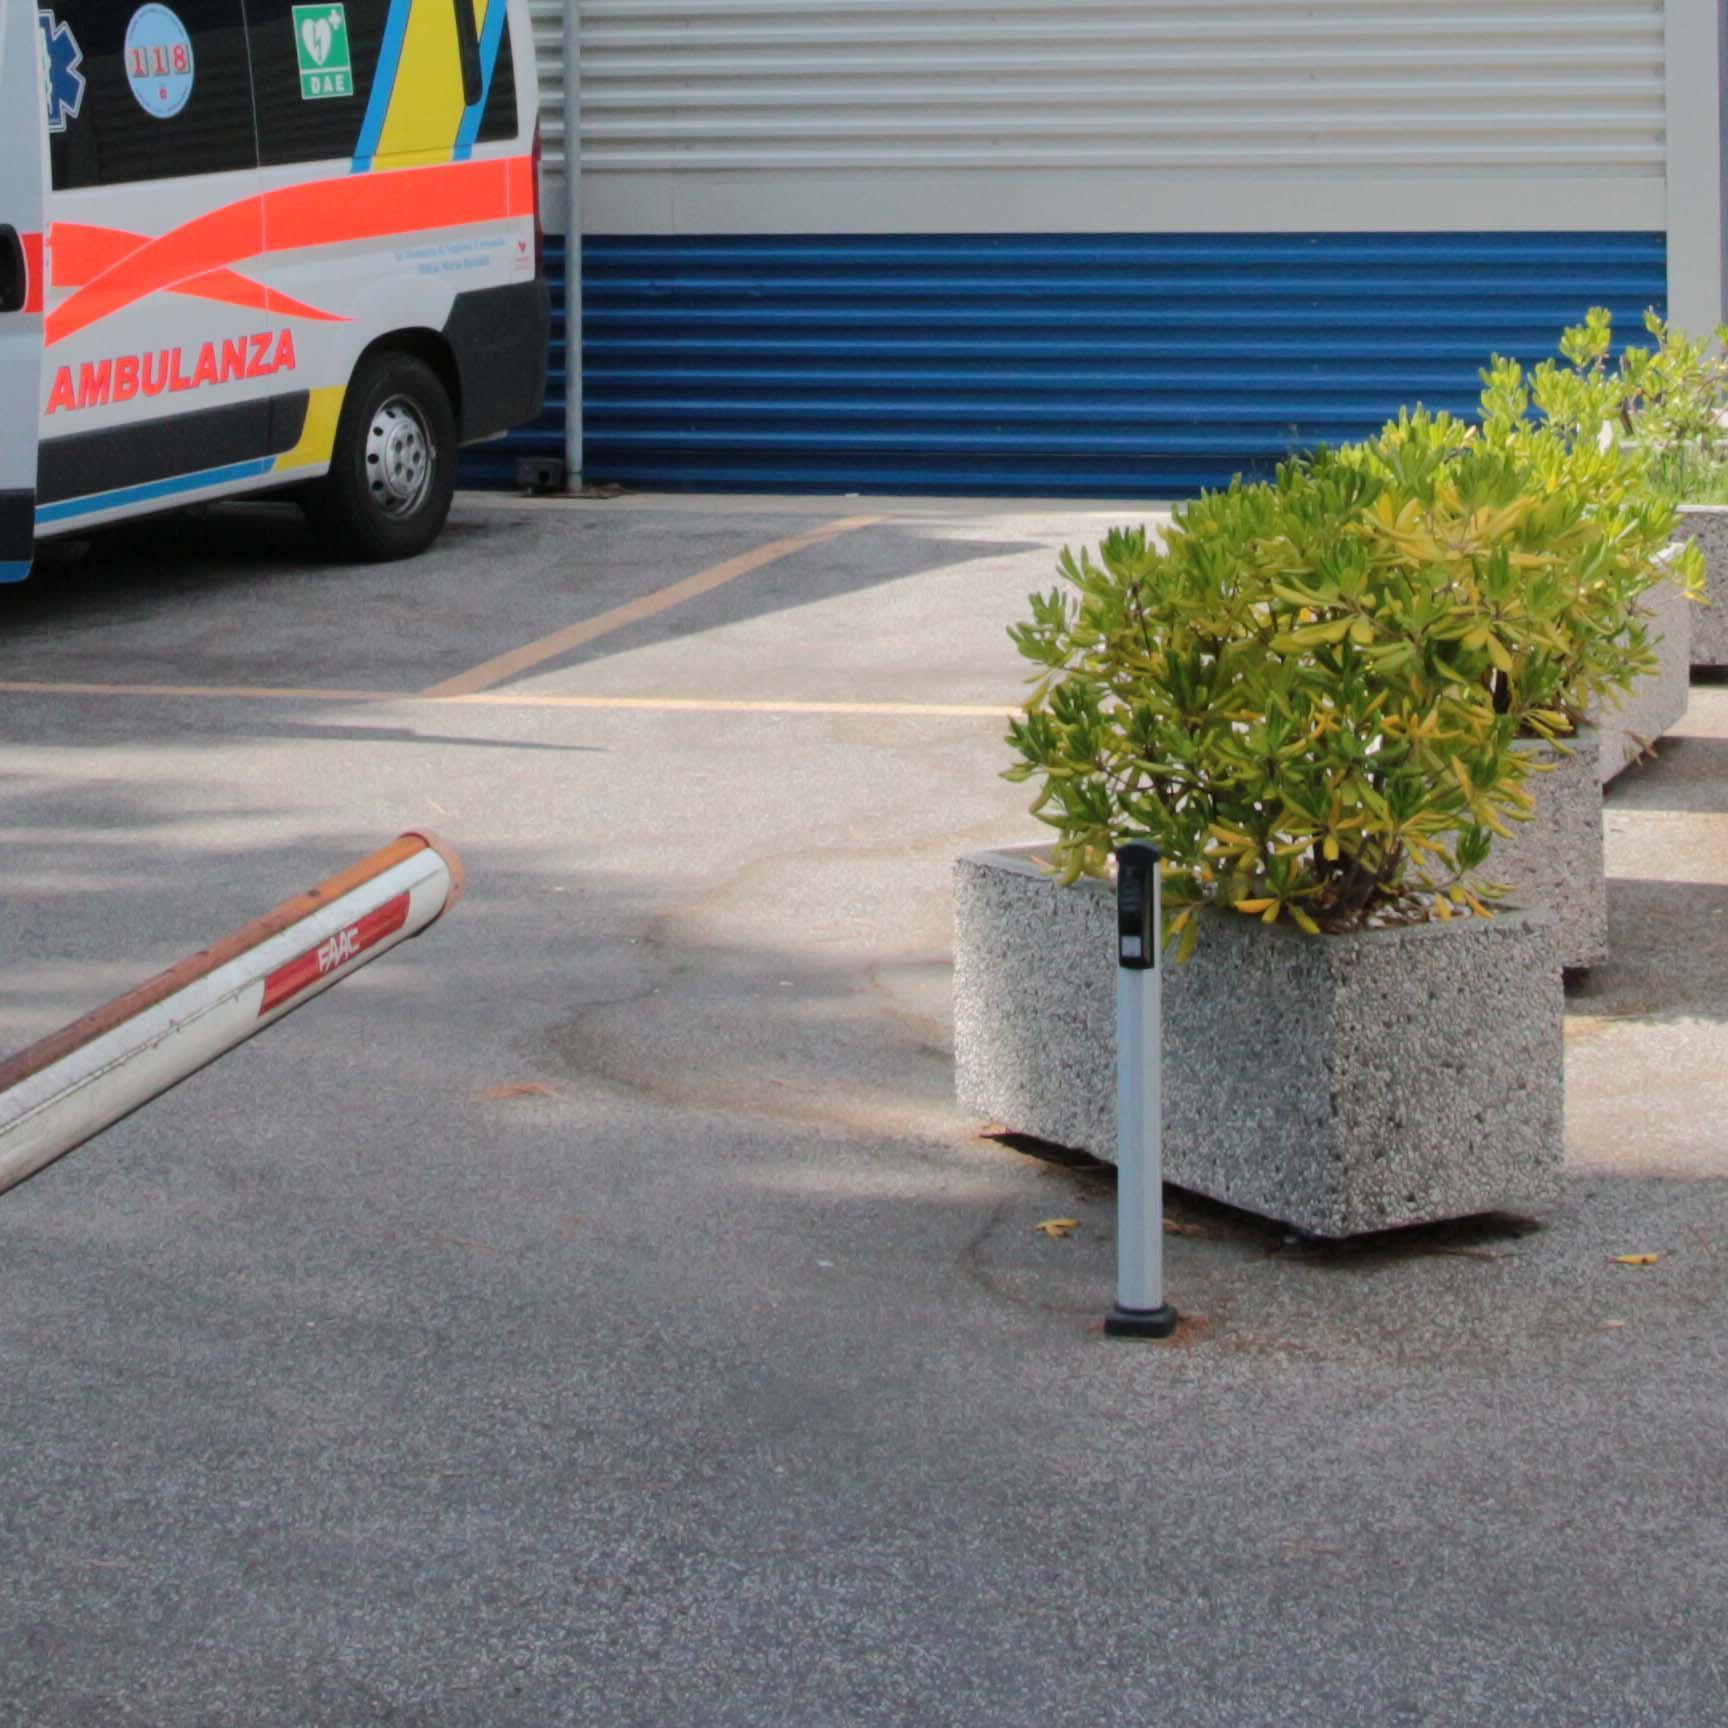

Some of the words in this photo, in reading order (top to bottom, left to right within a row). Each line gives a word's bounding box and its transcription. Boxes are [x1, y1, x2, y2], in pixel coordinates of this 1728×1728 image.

[131, 44, 188, 76] 118
[310, 73, 345, 94] DAE
[44, 328, 296, 415] AMBULANZA
[318, 927, 360, 973] FAAC
